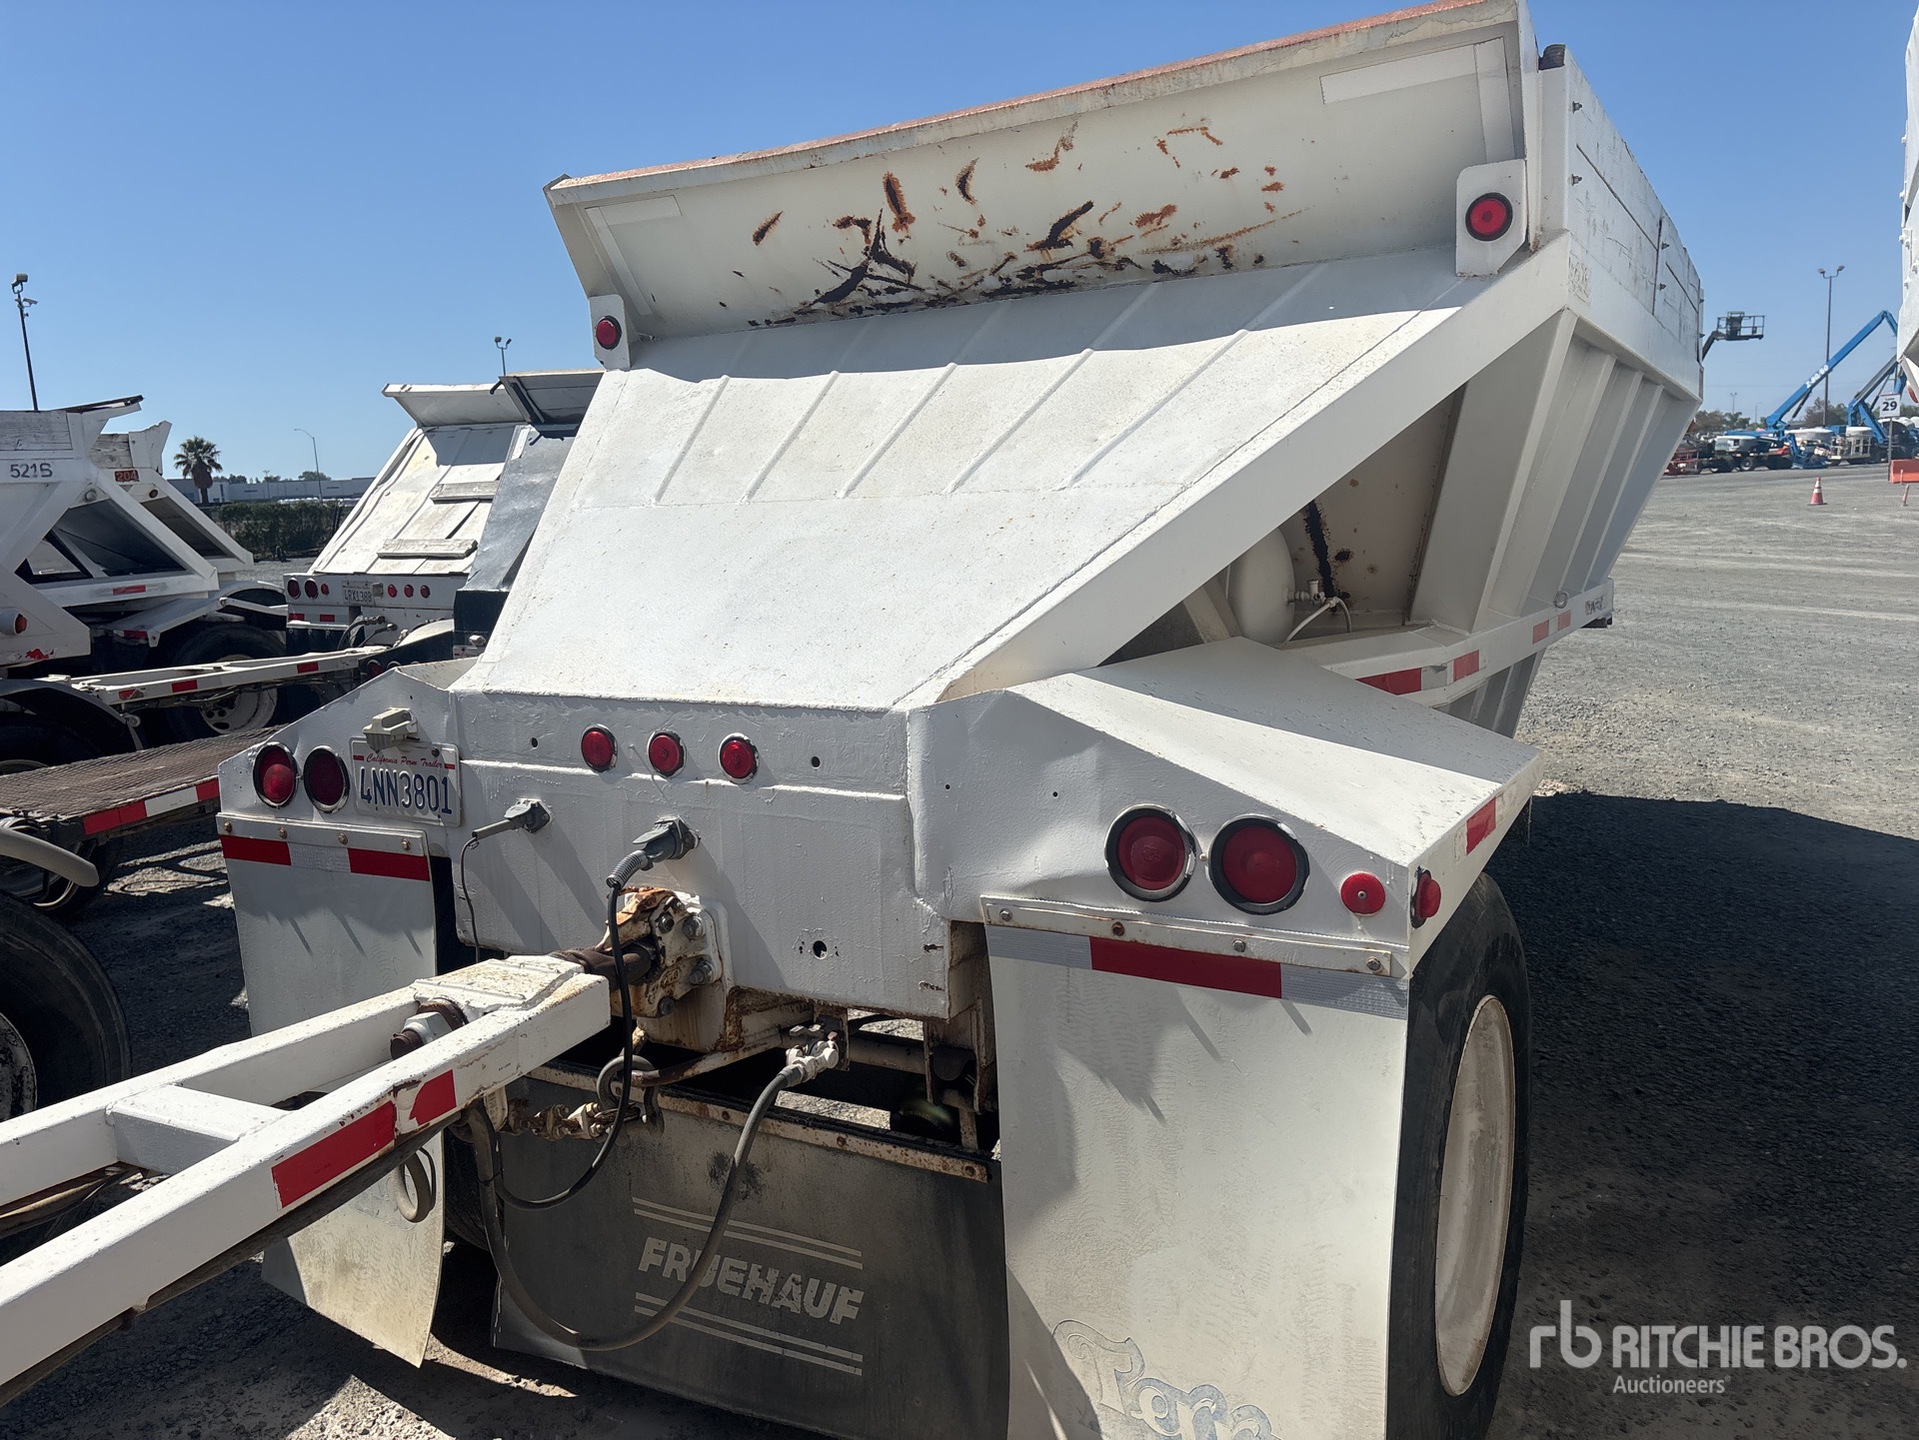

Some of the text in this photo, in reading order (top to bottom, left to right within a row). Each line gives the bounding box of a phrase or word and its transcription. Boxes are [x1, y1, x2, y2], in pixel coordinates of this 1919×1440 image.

[1882, 400, 1897, 411] 29
[366, 753, 442, 768] California Perm Trailer
[360, 766, 452, 815] 4NN3801
[638, 1236, 865, 1325] FRUEHAUF
